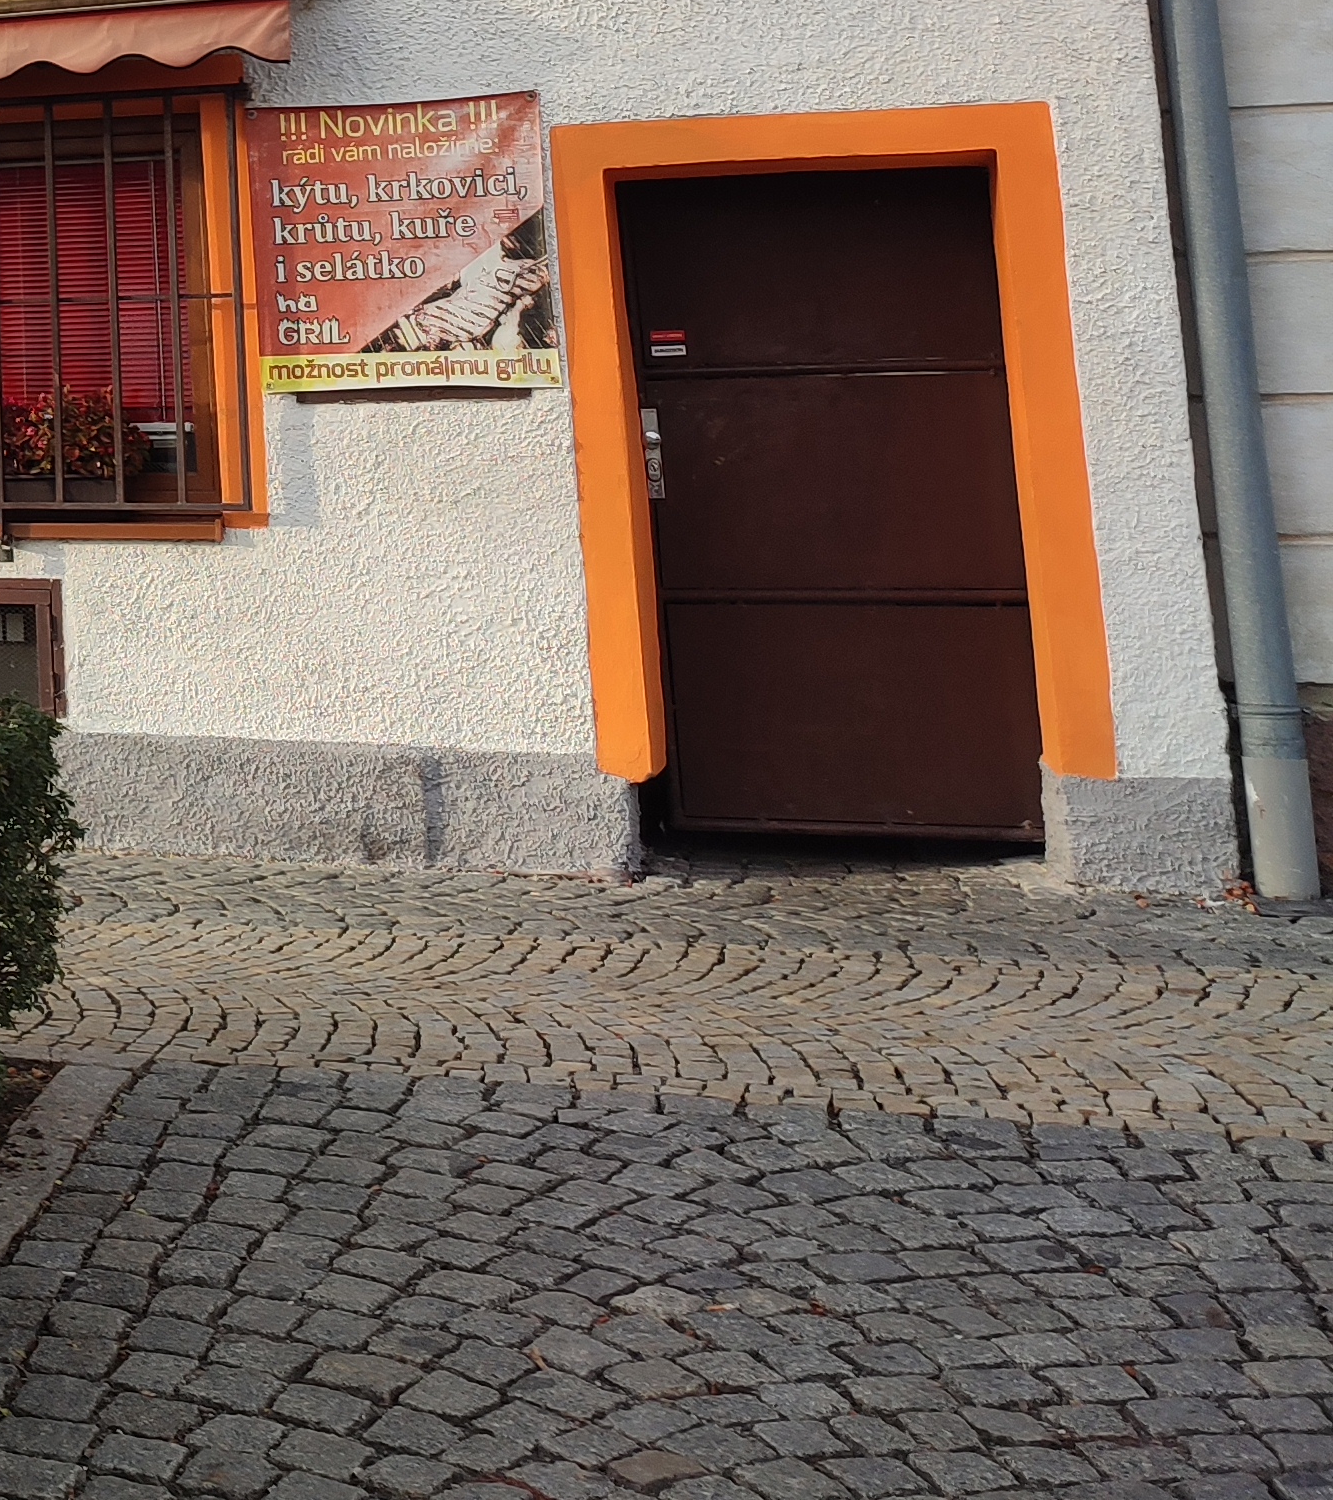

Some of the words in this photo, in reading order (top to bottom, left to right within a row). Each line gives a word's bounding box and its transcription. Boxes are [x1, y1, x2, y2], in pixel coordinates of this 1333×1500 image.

[319, 104, 458, 140] Novinka
[282, 143, 326, 165] rádi
[331, 142, 382, 162] vám
[387, 136, 500, 160] naložíme:
[270, 177, 359, 213] kýtu,
[365, 167, 528, 203] krkovici,
[273, 214, 382, 246] krůtu,
[390, 209, 477, 242] kuře
[275, 256, 287, 283] i
[296, 251, 426, 282] selátko
[278, 316, 350, 346] GRIL
[269, 358, 368, 381] možnost
[376, 355, 490, 384] pronájmu
